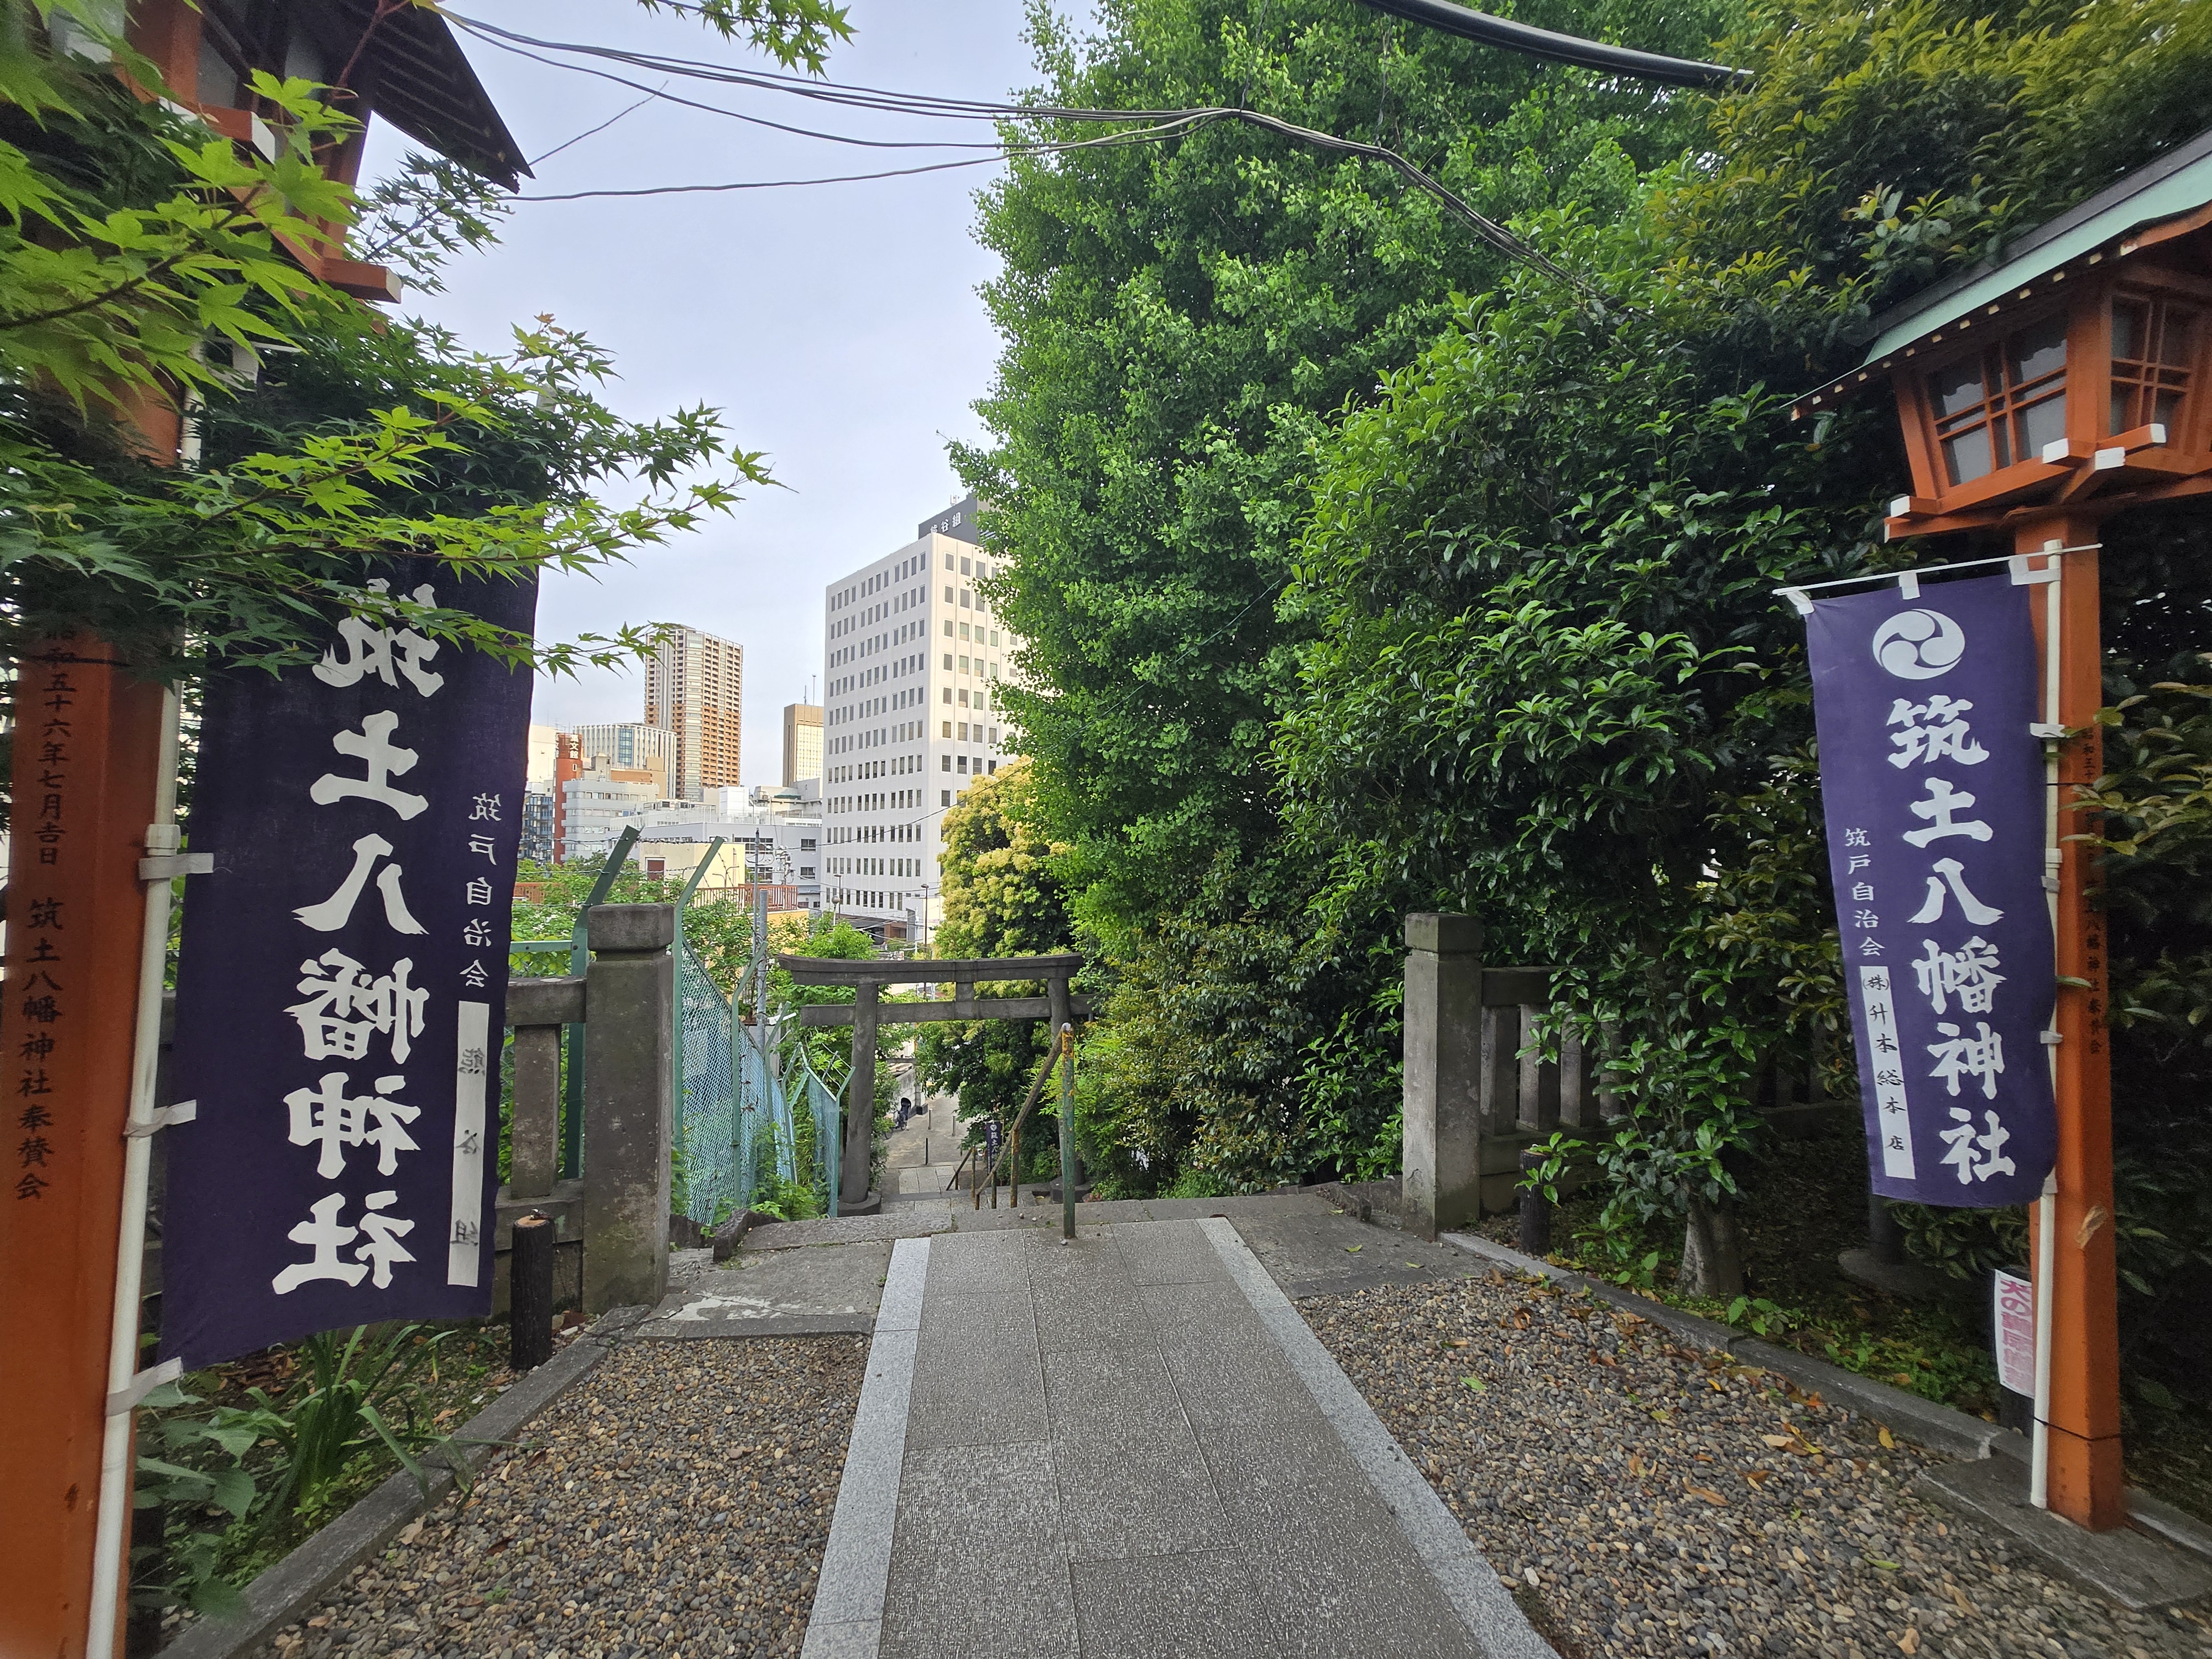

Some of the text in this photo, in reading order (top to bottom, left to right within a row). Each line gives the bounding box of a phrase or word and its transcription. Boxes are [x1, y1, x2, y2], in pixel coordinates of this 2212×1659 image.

[1845, 827, 1885, 957] 筑戸自治会
[1886, 695, 2016, 1185] 筑土八幡神社
[14, 897, 65, 1201] 筑土八幡神社奉賛会
